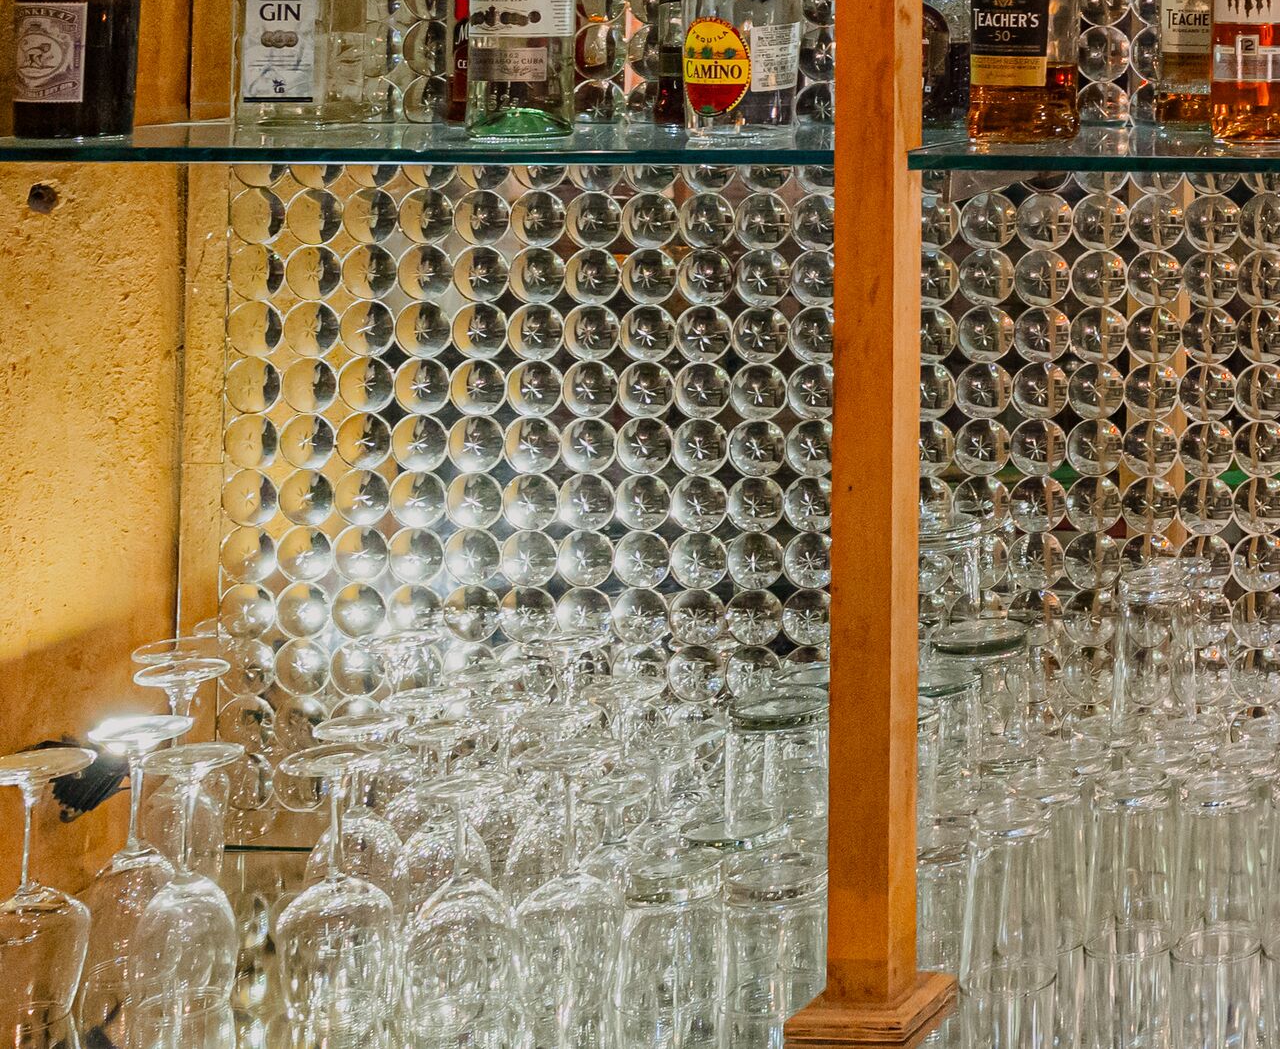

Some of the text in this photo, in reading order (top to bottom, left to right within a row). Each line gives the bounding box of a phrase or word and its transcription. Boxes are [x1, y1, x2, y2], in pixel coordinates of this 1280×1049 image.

[20, 8, 56, 17] ONKEY
[260, 3, 302, 22] GIN
[973, 8, 1039, 30] TEACHER'S
[1166, 9, 1209, 29] TEACHE
[692, 30, 728, 44] TEQUILA
[686, 60, 742, 80] CAMINO
